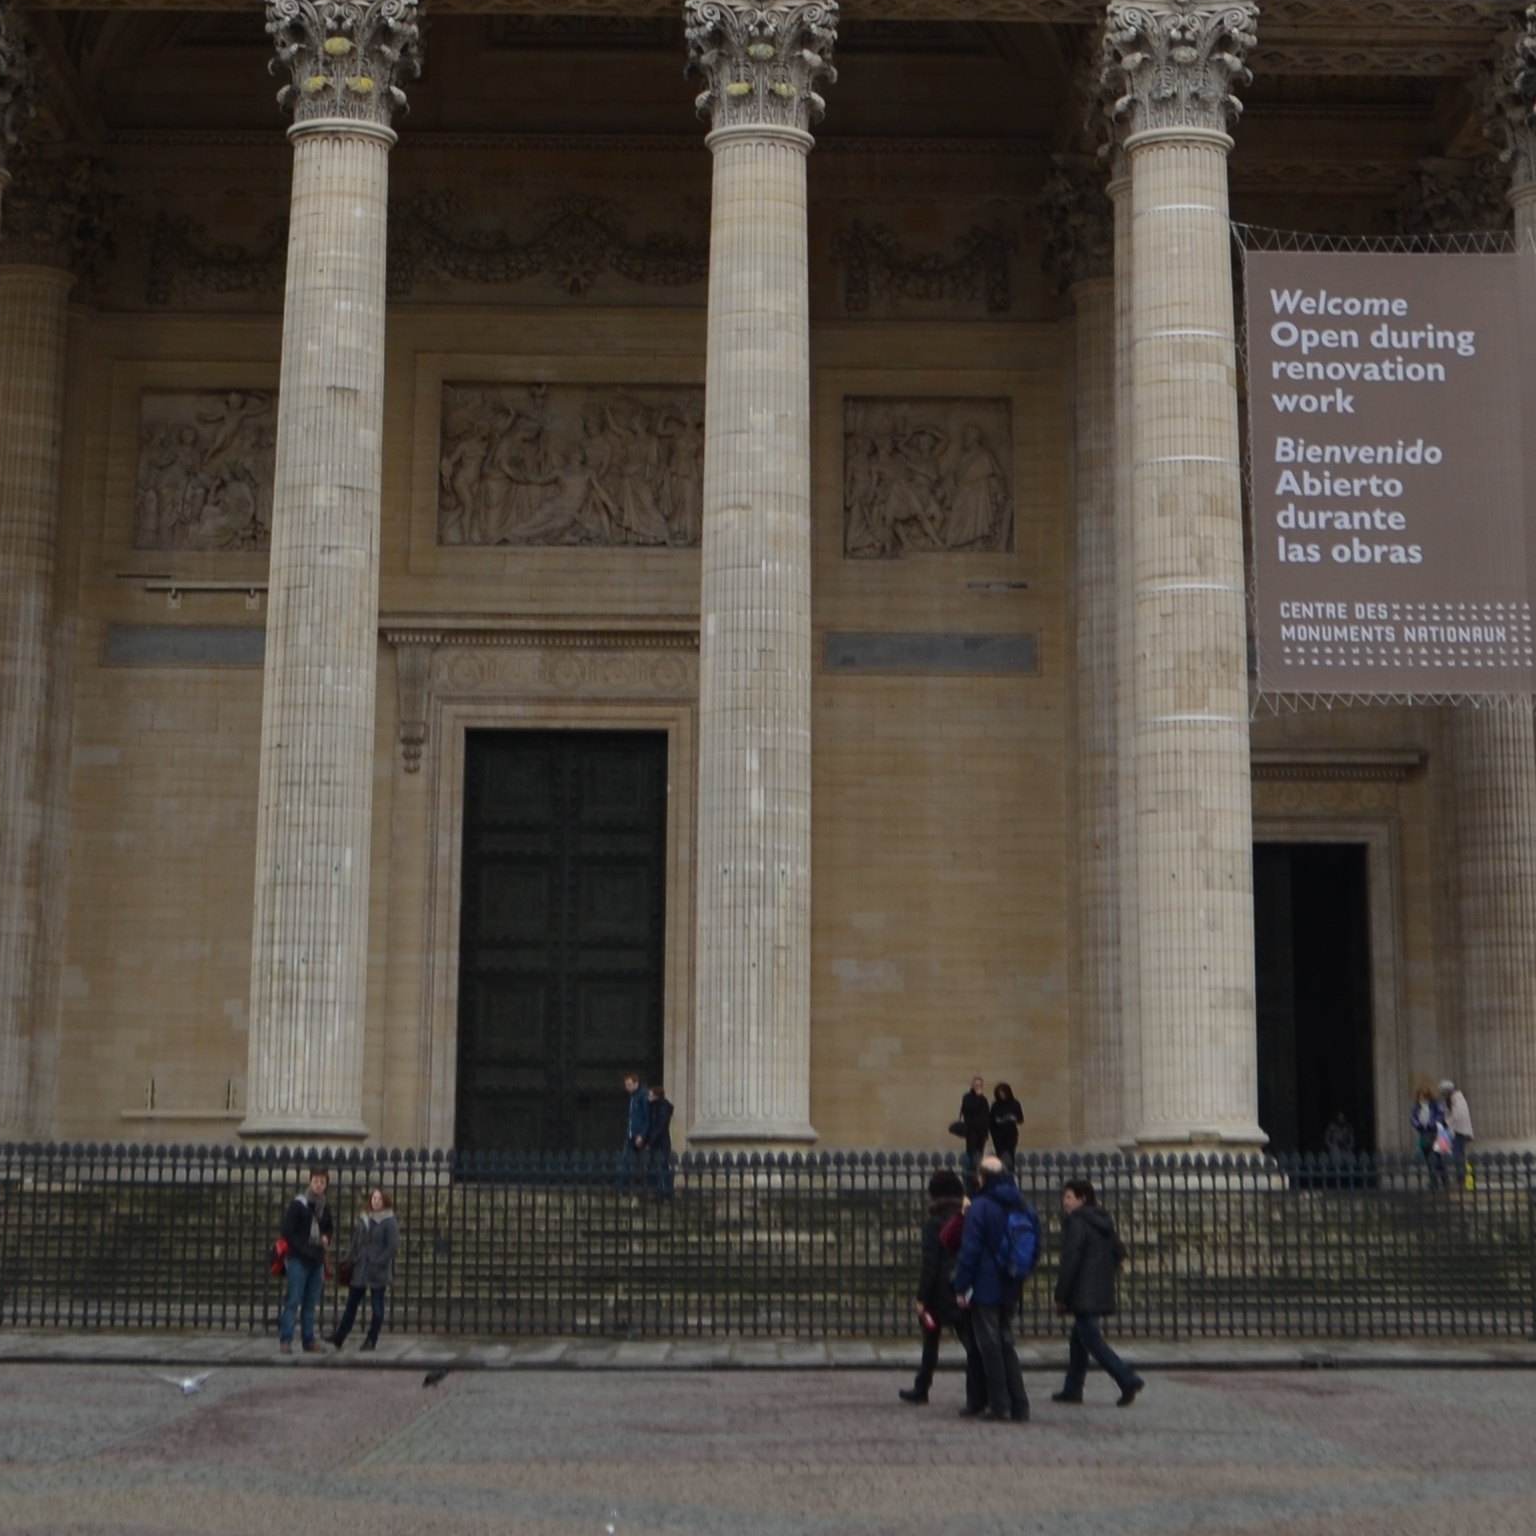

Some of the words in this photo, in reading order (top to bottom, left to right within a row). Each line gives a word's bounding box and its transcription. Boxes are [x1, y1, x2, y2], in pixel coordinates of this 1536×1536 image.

[1270, 289, 1407, 316] Welcome
[1271, 322, 1358, 354] Open
[1370, 323, 1475, 356] during
[1272, 356, 1445, 381] renovation
[1272, 388, 1354, 413] work
[1275, 437, 1442, 464] Bienvenido
[1276, 470, 1403, 497] Abierto
[1277, 503, 1405, 530] durante
[1278, 536, 1320, 562] las
[1332, 537, 1422, 563] obras
[1280, 602, 1347, 619] CENTRE
[1355, 603, 1387, 619] DES
[1281, 625, 1395, 642] MONUMENTS
[1404, 626, 1506, 642] NATIONAUX
